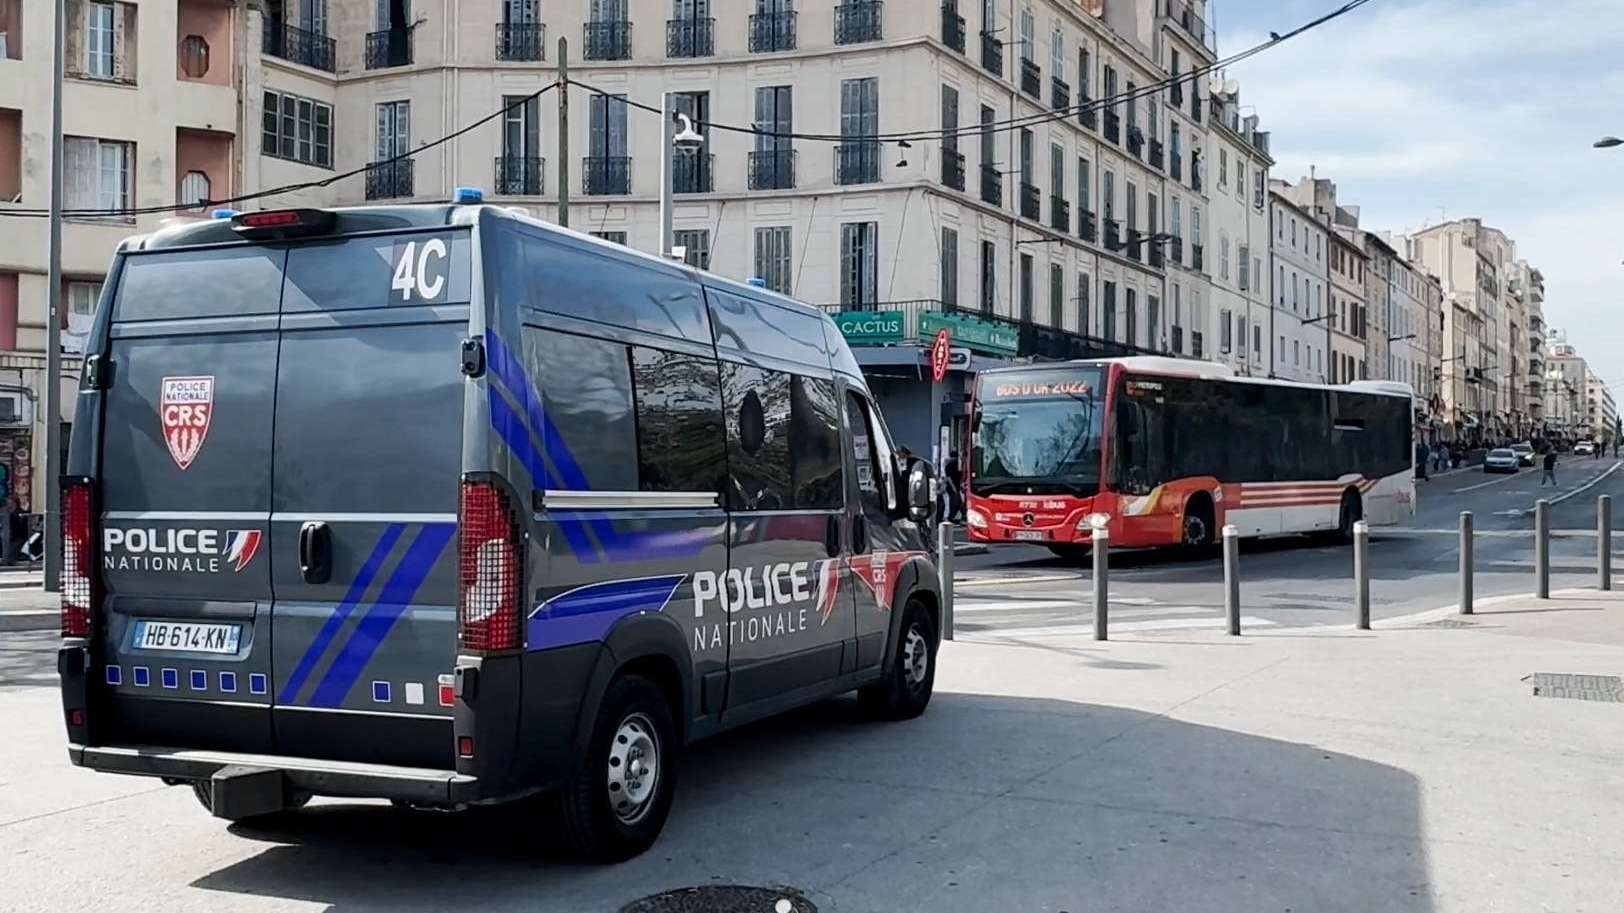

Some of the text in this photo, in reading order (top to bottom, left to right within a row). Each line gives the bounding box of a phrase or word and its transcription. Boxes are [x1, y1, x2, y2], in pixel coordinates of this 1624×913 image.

[391, 238, 447, 300] 4C
[841, 320, 899, 334] CACTUS
[166, 391, 209, 401] NATIONALE
[170, 382, 206, 392] POLICE
[165, 405, 207, 427] CRS
[104, 528, 218, 554] POLICE
[104, 556, 219, 573] NATIONALE
[692, 561, 809, 618] POLICE
[694, 608, 807, 652] NATIONALE
